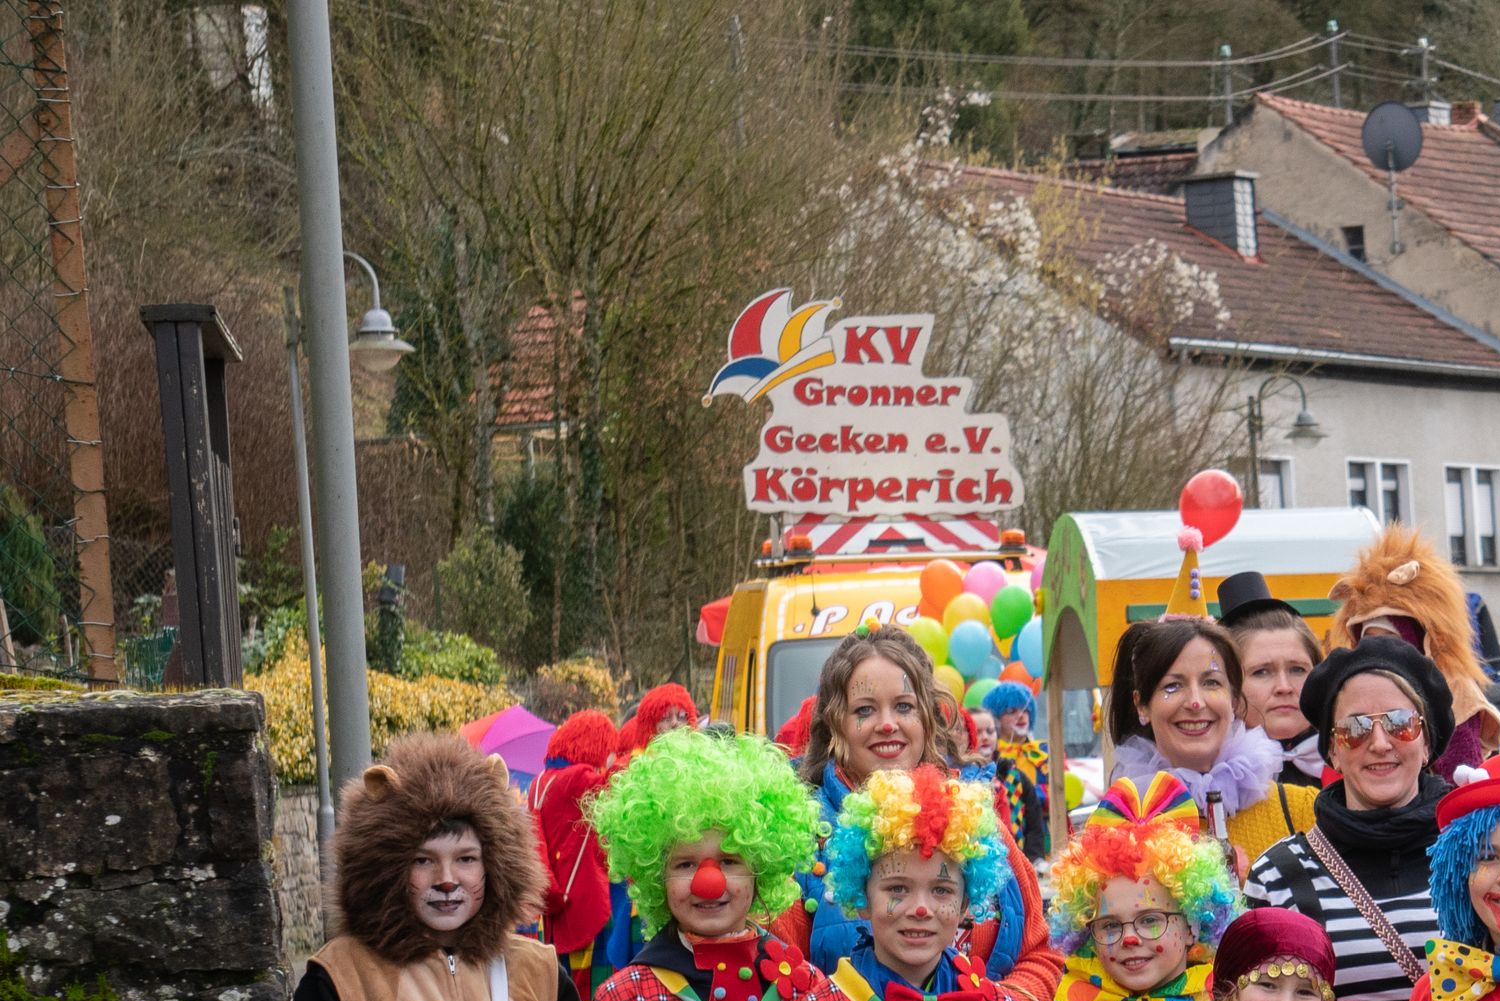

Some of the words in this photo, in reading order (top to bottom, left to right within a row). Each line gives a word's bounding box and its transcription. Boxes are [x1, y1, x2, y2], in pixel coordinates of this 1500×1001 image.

[843, 326, 923, 365] KV
[793, 377, 962, 407] Gronner
[764, 425, 909, 454] Gecken
[925, 426, 1002, 454] e.V.
[751, 467, 1014, 511] Körperich
